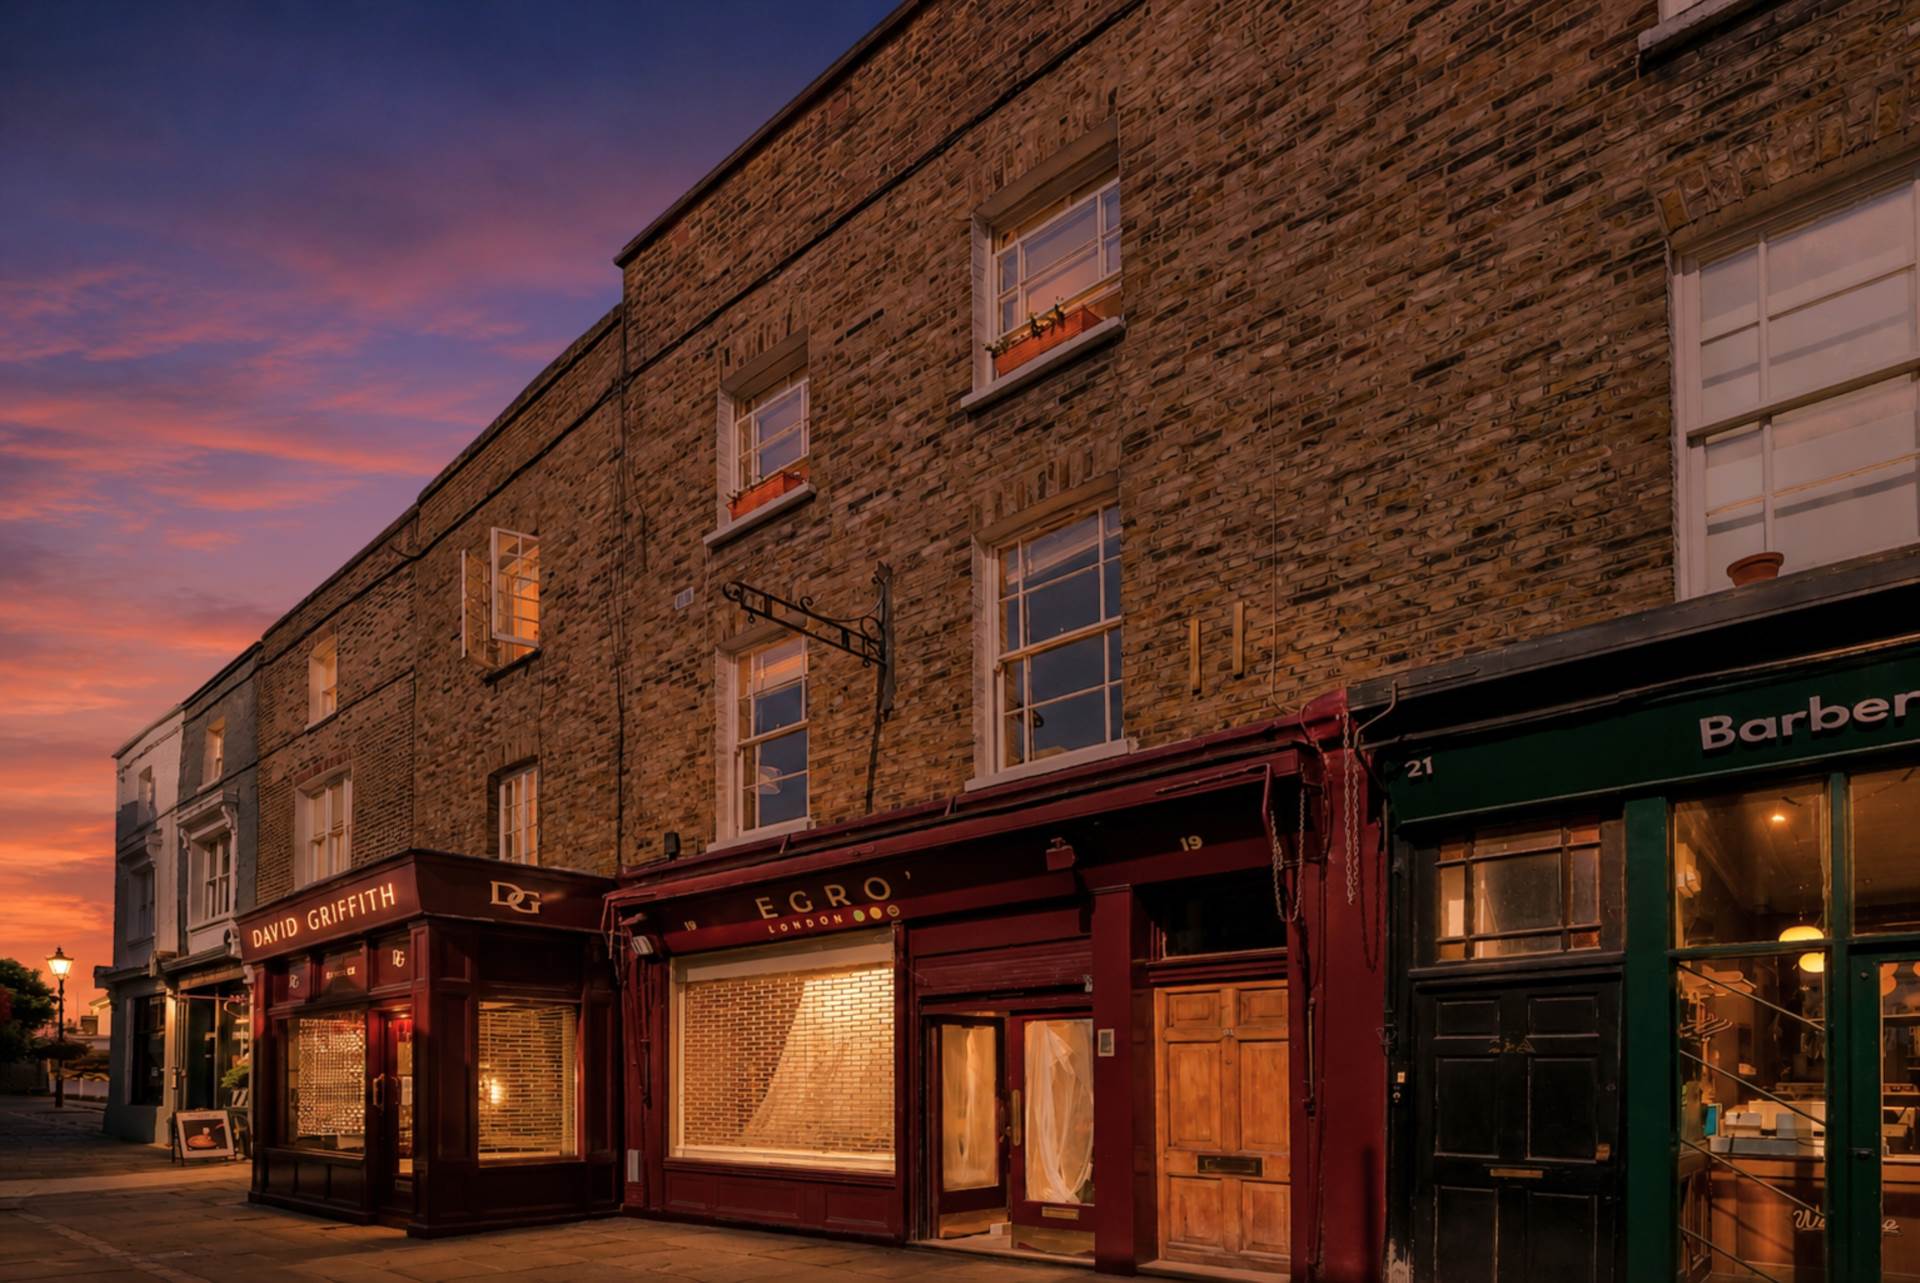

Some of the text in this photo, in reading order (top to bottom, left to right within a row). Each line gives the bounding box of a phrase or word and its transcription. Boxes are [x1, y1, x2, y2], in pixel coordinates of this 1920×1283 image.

[1404, 756, 1433, 778] 21
[1180, 835, 1203, 851] 19
[490, 880, 541, 914] DG
[252, 882, 396, 948] DAVID GRIFFITH
[684, 920, 697, 931] 19
[768, 914, 843, 934] LONDON
